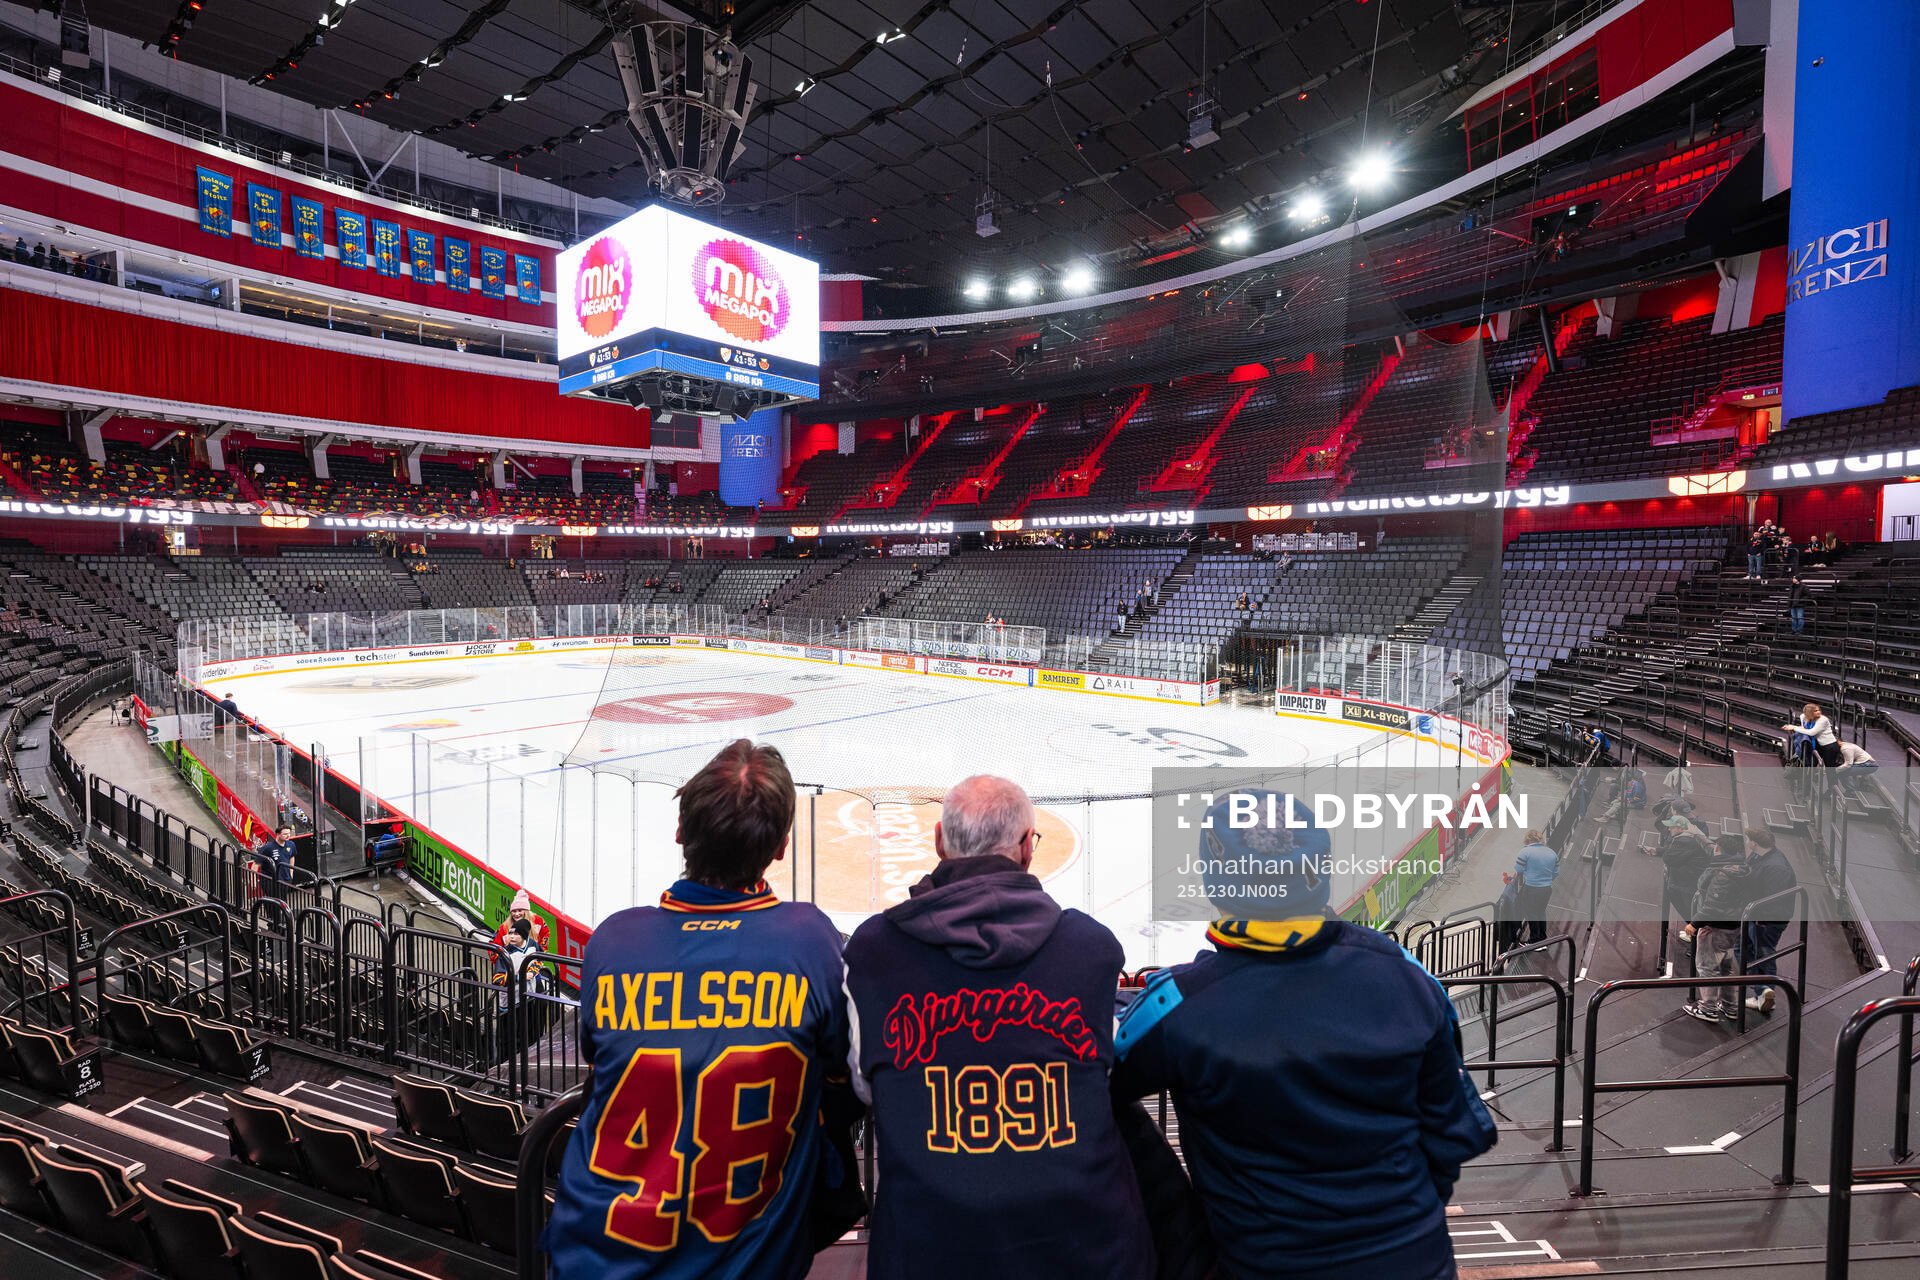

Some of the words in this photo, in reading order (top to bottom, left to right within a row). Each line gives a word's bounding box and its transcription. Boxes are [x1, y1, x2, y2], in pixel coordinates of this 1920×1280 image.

[200, 175, 230, 190] Roland
[212, 185, 219, 193] 2
[302, 211, 314, 220] 12
[344, 222, 357, 230] 27
[380, 232, 393, 241] 22
[417, 242, 426, 250] 11
[581, 294, 624, 318] MEGAPOL
[704, 289, 777, 329] MEGAPOL
[597, 351, 611, 363] 41:53
[734, 354, 756, 367] 41:53
[752, 376, 763, 387] KR
[466, 644, 497, 652] HOCKEY
[356, 652, 396, 662] techster
[938, 660, 962, 668] NORDIC
[934, 667, 967, 676] WELLNESS
[978, 668, 1014, 678] CCM
[1043, 674, 1080, 685] RAMIRENT
[1107, 679, 1134, 690] RAIL
[1280, 695, 1314, 710] IMPACT
[1316, 698, 1327, 711] BY
[1363, 708, 1406, 724] XL-BYGG
[681, 919, 742, 932] CCM
[594, 970, 809, 1032] AXELSSON
[882, 982, 1098, 1070] Djurgården
[252, 1048, 262, 1056] RAD
[78, 1059, 91, 1068] RAD
[254, 1054, 262, 1066] 7
[80, 1066, 92, 1079] 8
[252, 1064, 266, 1074] PLATS
[79, 1078, 96, 1089] PLATS
[925, 1062, 1076, 1154] 1891
[588, 1041, 809, 1252] 48
